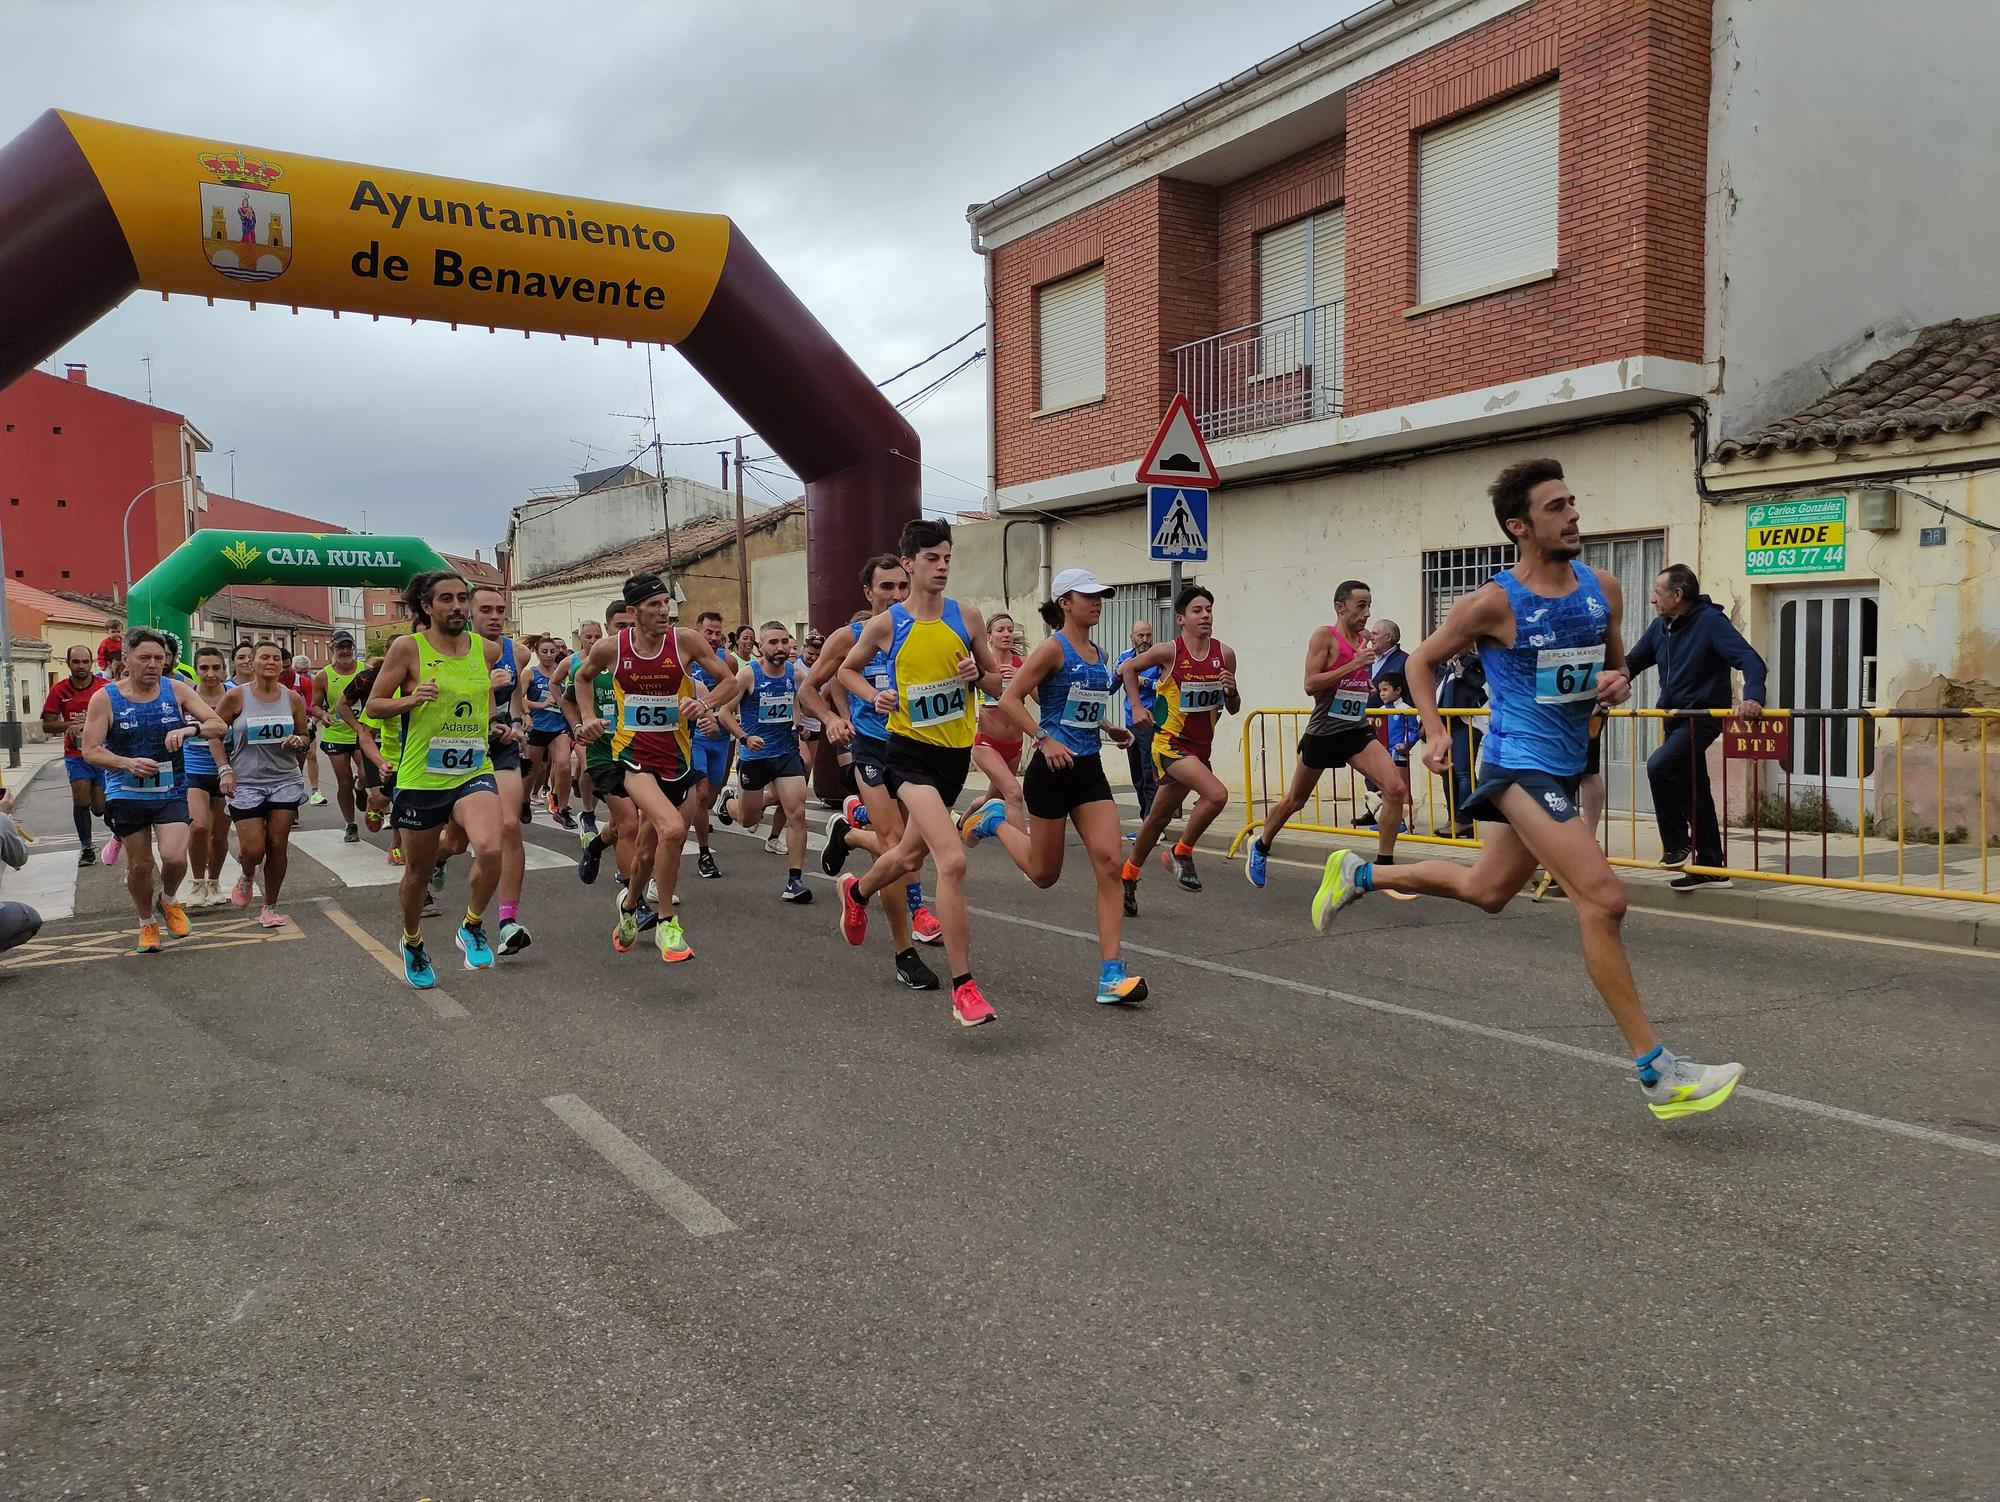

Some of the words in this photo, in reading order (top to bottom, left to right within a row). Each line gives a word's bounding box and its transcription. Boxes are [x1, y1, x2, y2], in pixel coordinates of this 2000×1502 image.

[349, 179, 676, 253] Ayuntamiento
[350, 240, 410, 281] de
[433, 248, 667, 310] Benavente
[1768, 506, 1796, 516] Carlos
[1798, 502, 1842, 513] González
[1759, 526, 1829, 547] VENDE
[266, 547, 321, 566] CAJA
[327, 549, 401, 567] RURAL
[1747, 551, 1774, 567] 980
[1777, 549, 1796, 566] 63
[1801, 548, 1821, 565] 77
[1823, 546, 1843, 563] 44
[917, 684, 936, 692] PLAZA
[937, 680, 957, 688] MAYOR
[1555, 663, 1594, 695] 67
[915, 687, 965, 719] 104
[1185, 689, 1221, 708] 108
[1341, 699, 1361, 716] 99
[635, 705, 668, 726] 65
[767, 703, 788, 719] 42
[1074, 701, 1100, 722] 58
[257, 723, 285, 740] 40
[440, 722, 479, 732] Adarsa
[1366, 717, 1382, 727] TO
[1730, 720, 1784, 734] AYTO
[1736, 738, 1776, 752] BTE
[441, 748, 475, 769] 64
[398, 816, 422, 826] Adarsa
